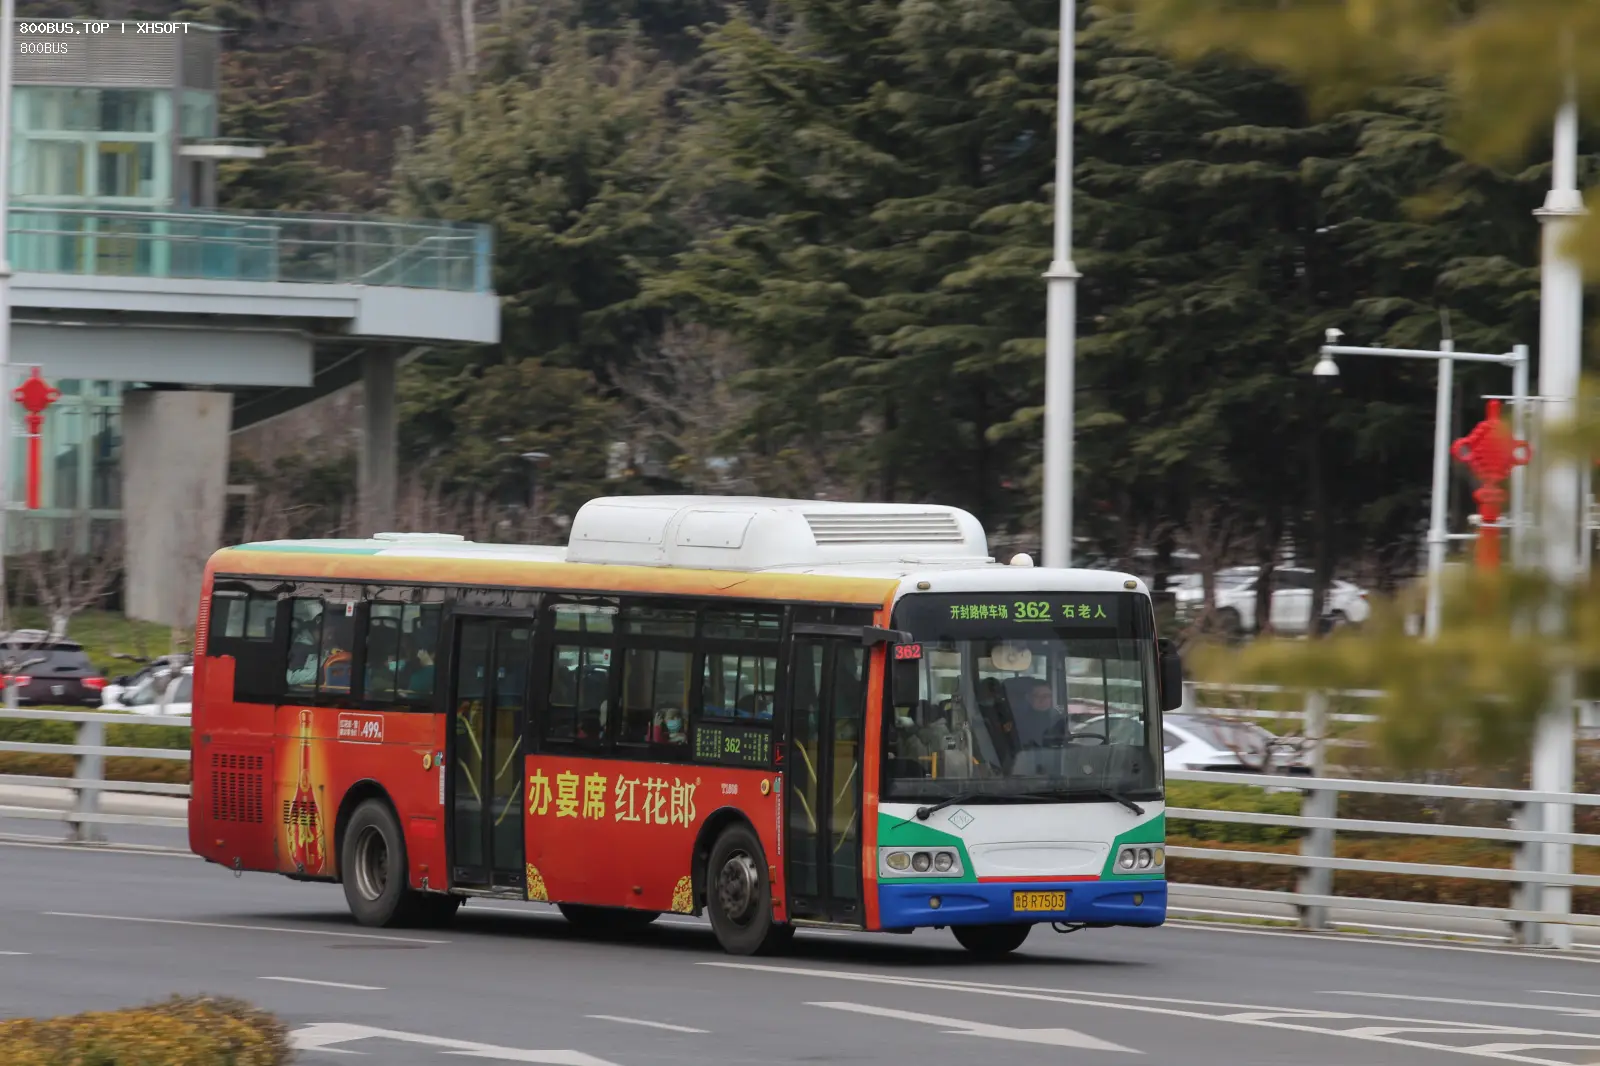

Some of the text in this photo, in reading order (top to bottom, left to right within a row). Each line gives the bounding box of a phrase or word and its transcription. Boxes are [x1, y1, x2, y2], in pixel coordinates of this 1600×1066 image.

[950, 601, 1107, 620] 开封路停车场 362 石老人
[895, 643, 921, 659] 362
[724, 737, 741, 754] 362
[529, 768, 696, 828] 办宴席 红花郎
